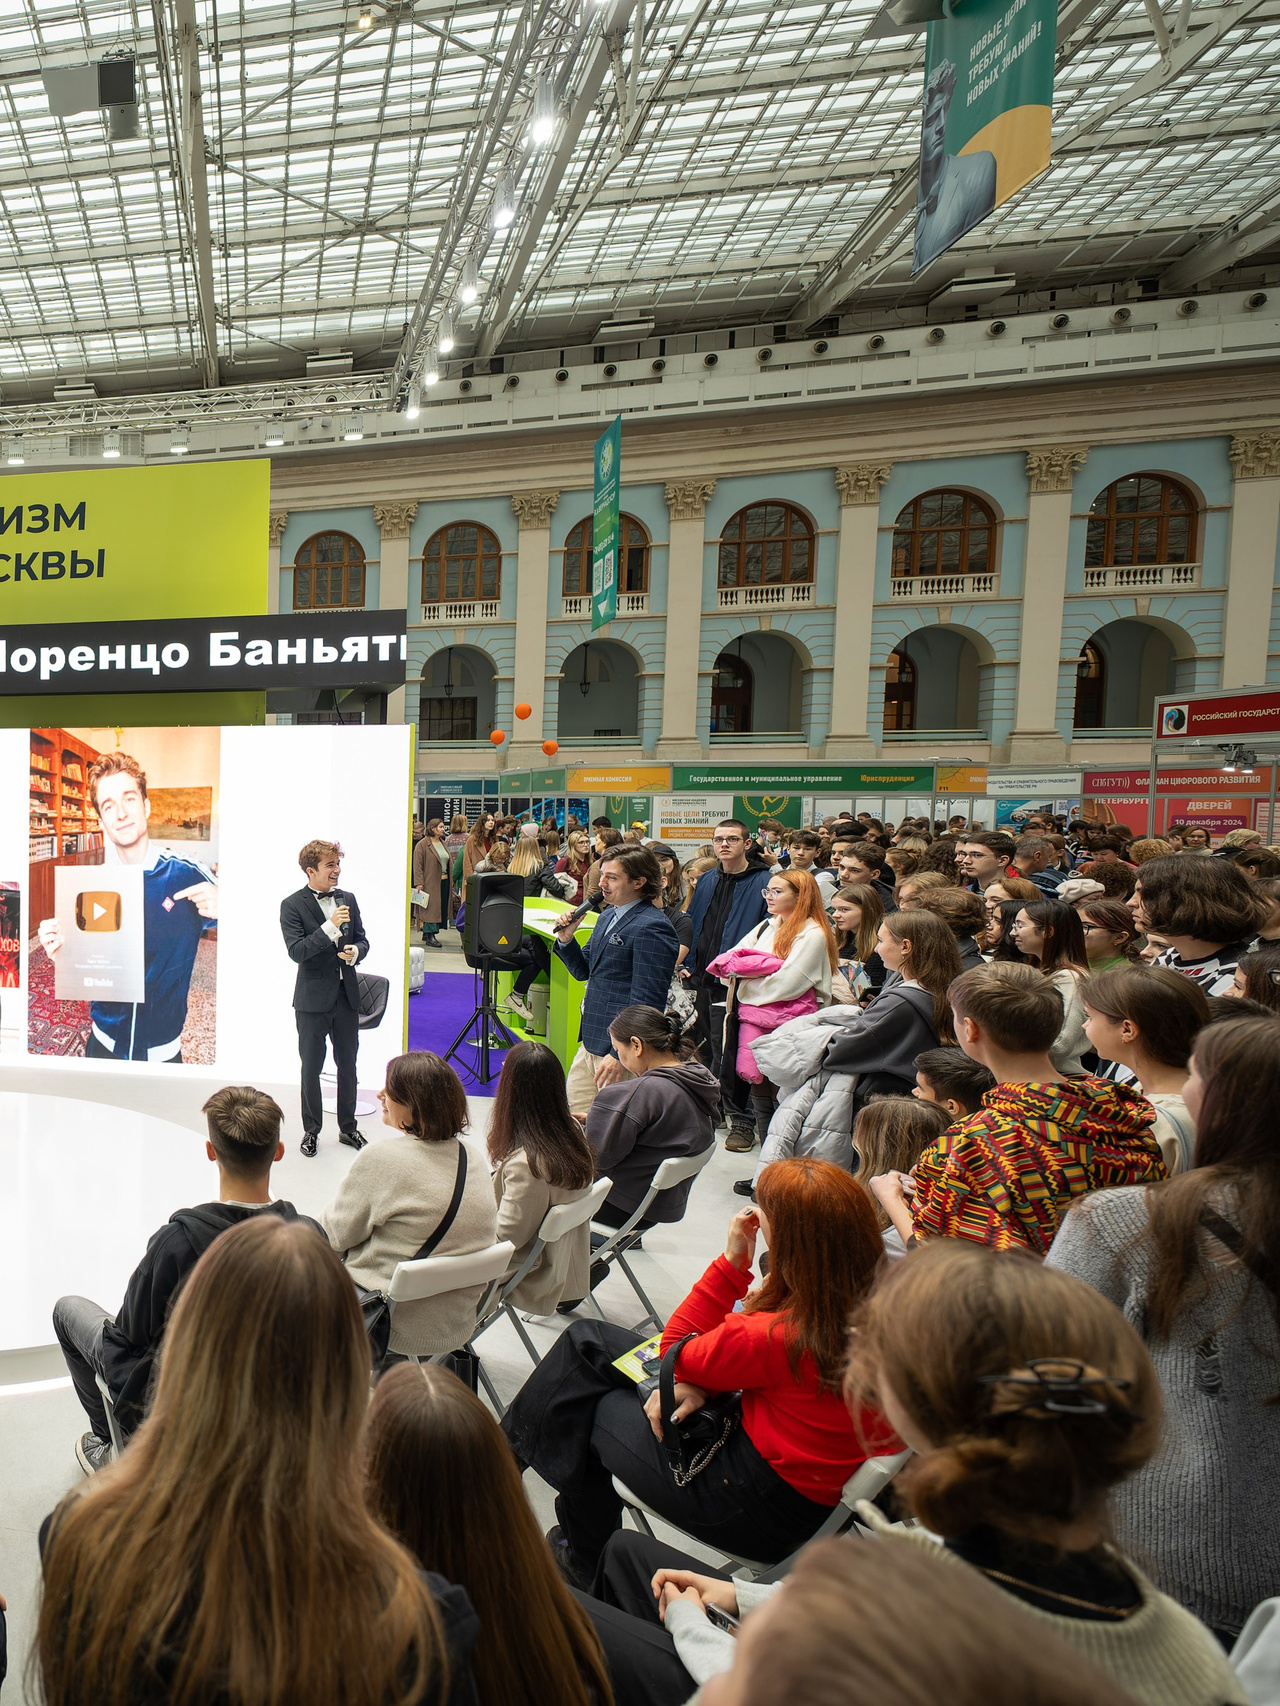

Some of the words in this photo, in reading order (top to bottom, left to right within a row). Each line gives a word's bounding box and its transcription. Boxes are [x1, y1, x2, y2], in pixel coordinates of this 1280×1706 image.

[969, 18, 1003, 63] НОВЫЕ
[966, 63, 1000, 108] НОВЫХ
[1001, 20, 1043, 73] ЗНАНИЙ!
[968, 33, 1009, 84] ТРЕБУЮТ
[1191, 710, 1238, 722] РОССИЙСКИЙ
[689, 774, 744, 783] Государственное
[750, 774, 802, 784] муниципальное
[802, 775, 843, 783] управление
[860, 774, 915, 783] Юриспруденция
[1170, 776, 1218, 786] ЦИФРОВОГО
[1218, 775, 1261, 784] РАЗВИТИЯ
[1186, 800, 1232, 811] ДВЕРЕЙ
[684, 817, 709, 825] ЗНАНИЙ
